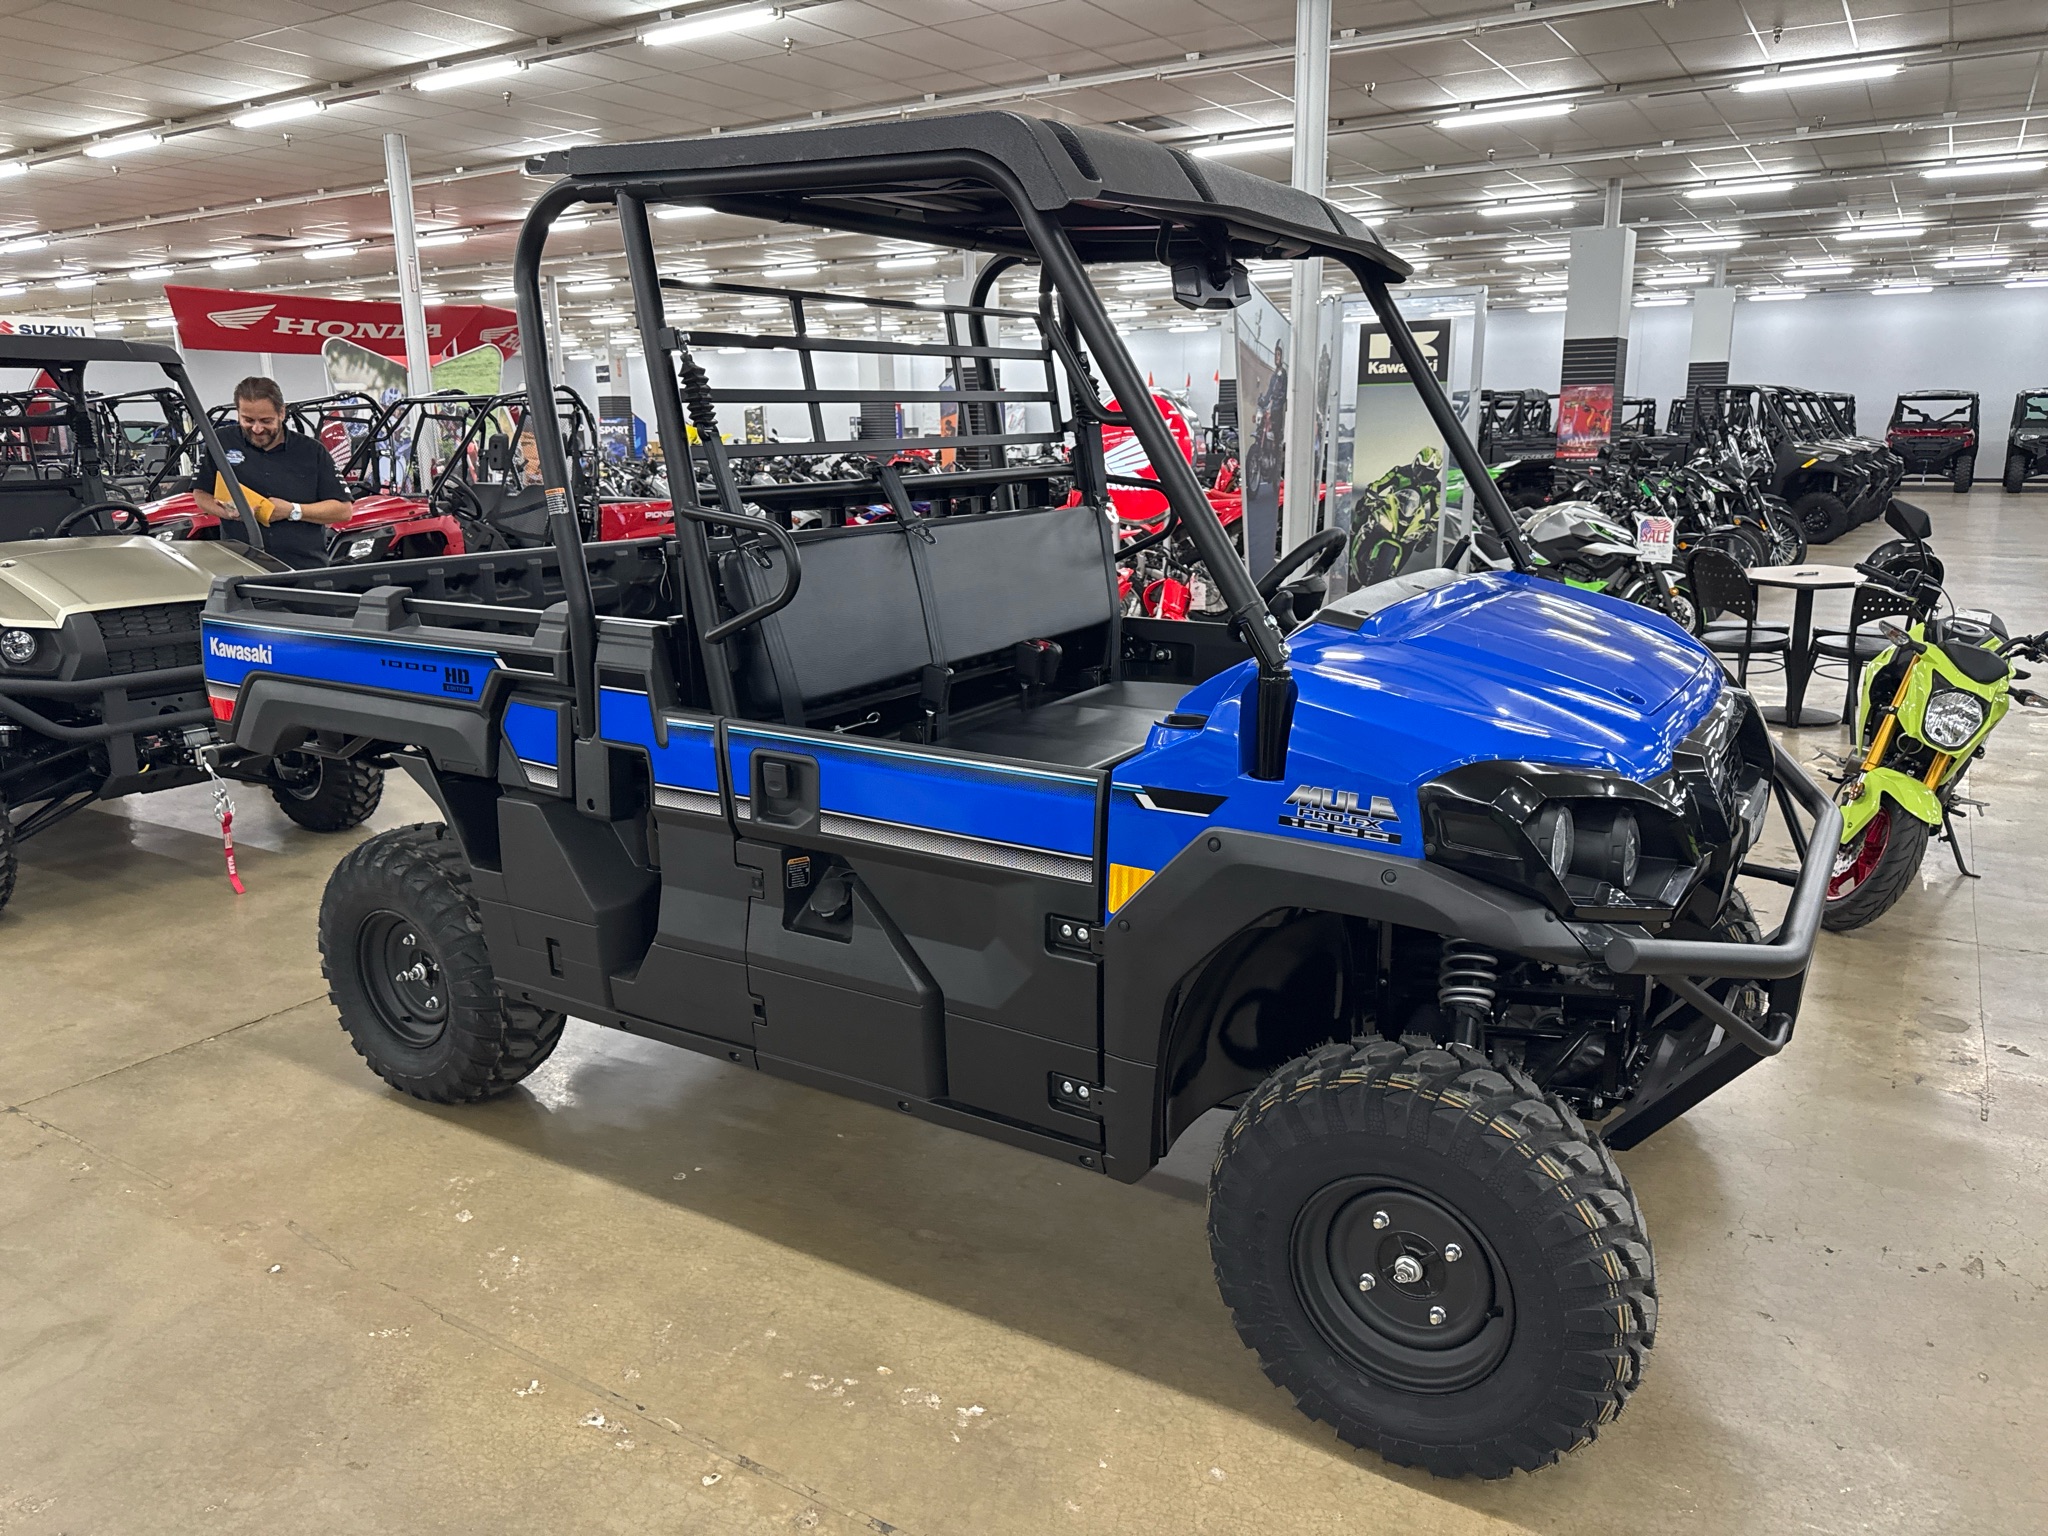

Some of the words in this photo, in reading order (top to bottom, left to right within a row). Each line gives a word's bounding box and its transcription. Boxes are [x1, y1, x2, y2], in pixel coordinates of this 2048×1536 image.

[18, 323, 86, 337] SUZUKI
[599, 425, 629, 435] SPORT
[644, 510, 674, 519] PIONE
[1641, 528, 1670, 544] SALE
[209, 636, 272, 665] Kawasaki
[381, 658, 437, 673] 1000
[444, 666, 470, 684] HD
[446, 685, 470, 694] EDITION
[1283, 784, 1401, 823] MULE
[1290, 816, 1391, 843] 1000
